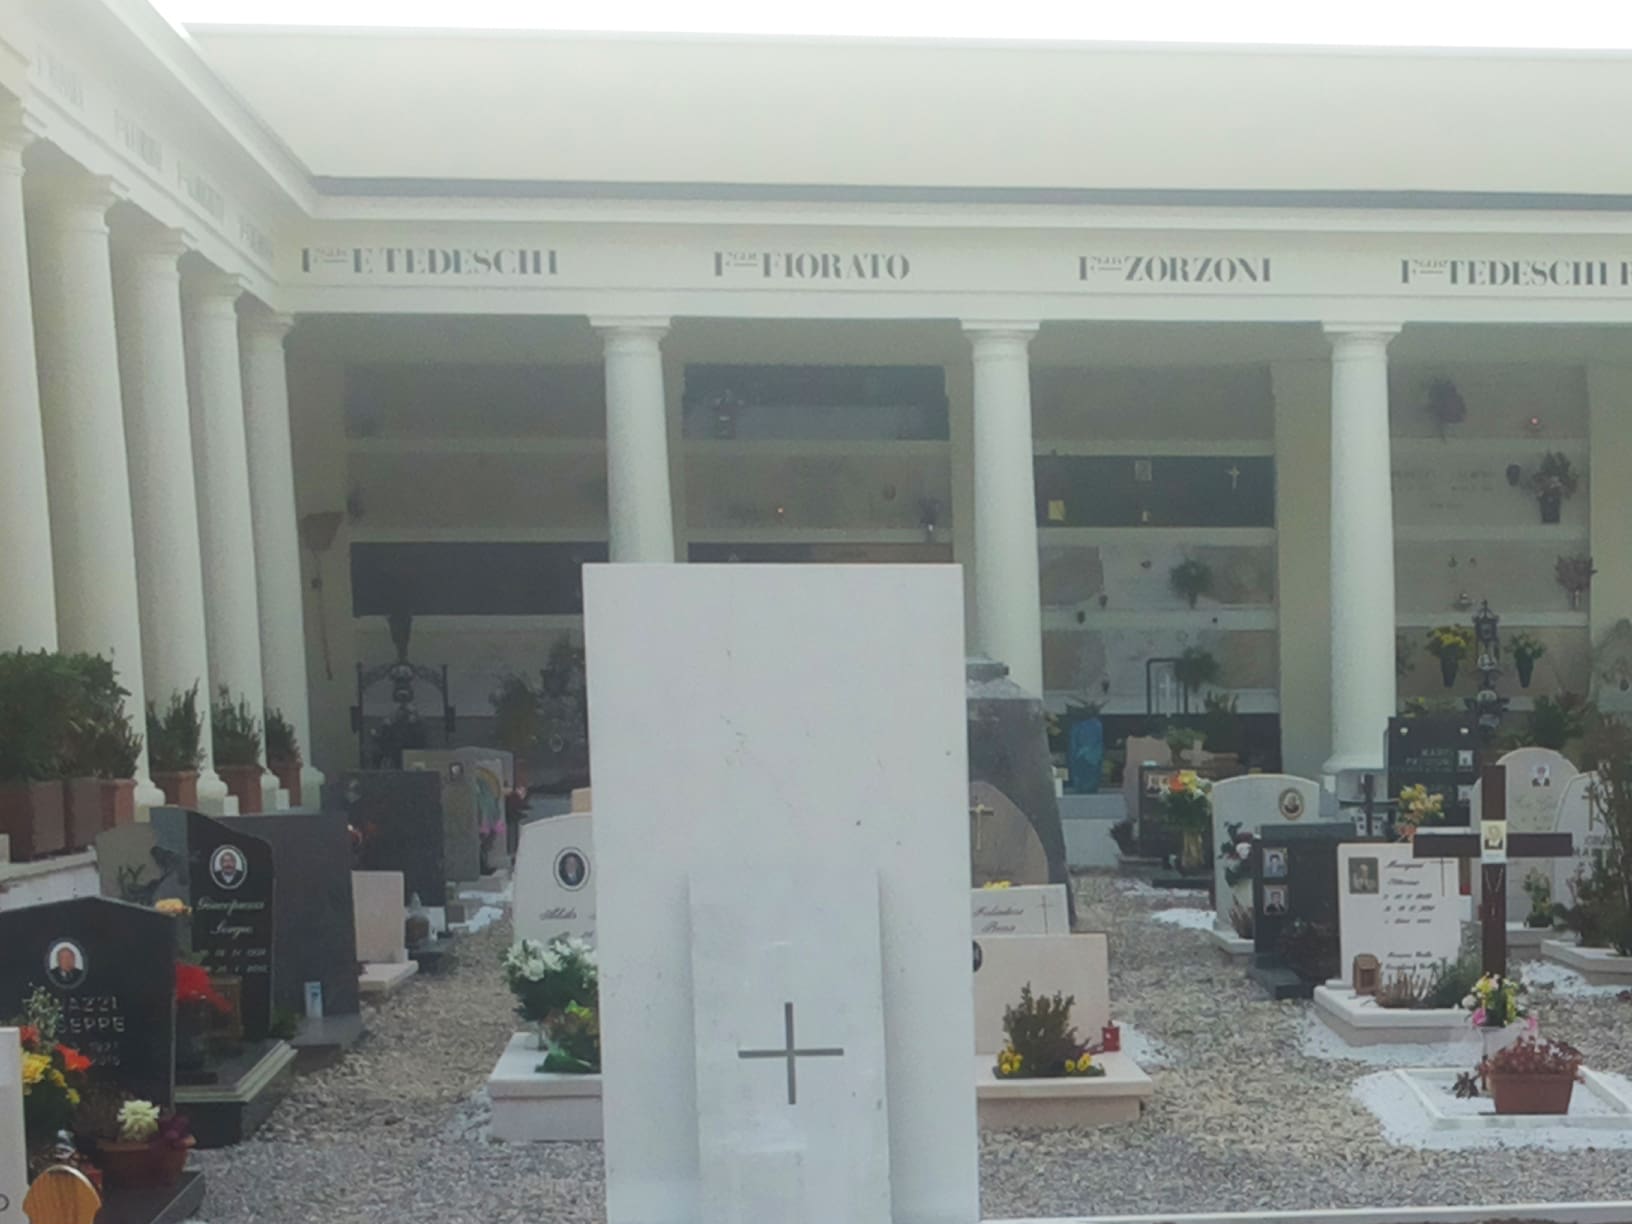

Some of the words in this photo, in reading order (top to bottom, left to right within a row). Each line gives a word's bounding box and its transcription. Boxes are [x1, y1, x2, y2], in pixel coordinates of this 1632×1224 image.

[381, 248, 558, 275] TEDESCHI
[763, 252, 910, 279] FIORATO
[1125, 256, 1271, 283] ZORZONI
[1449, 259, 1608, 286] TEDESCHI
